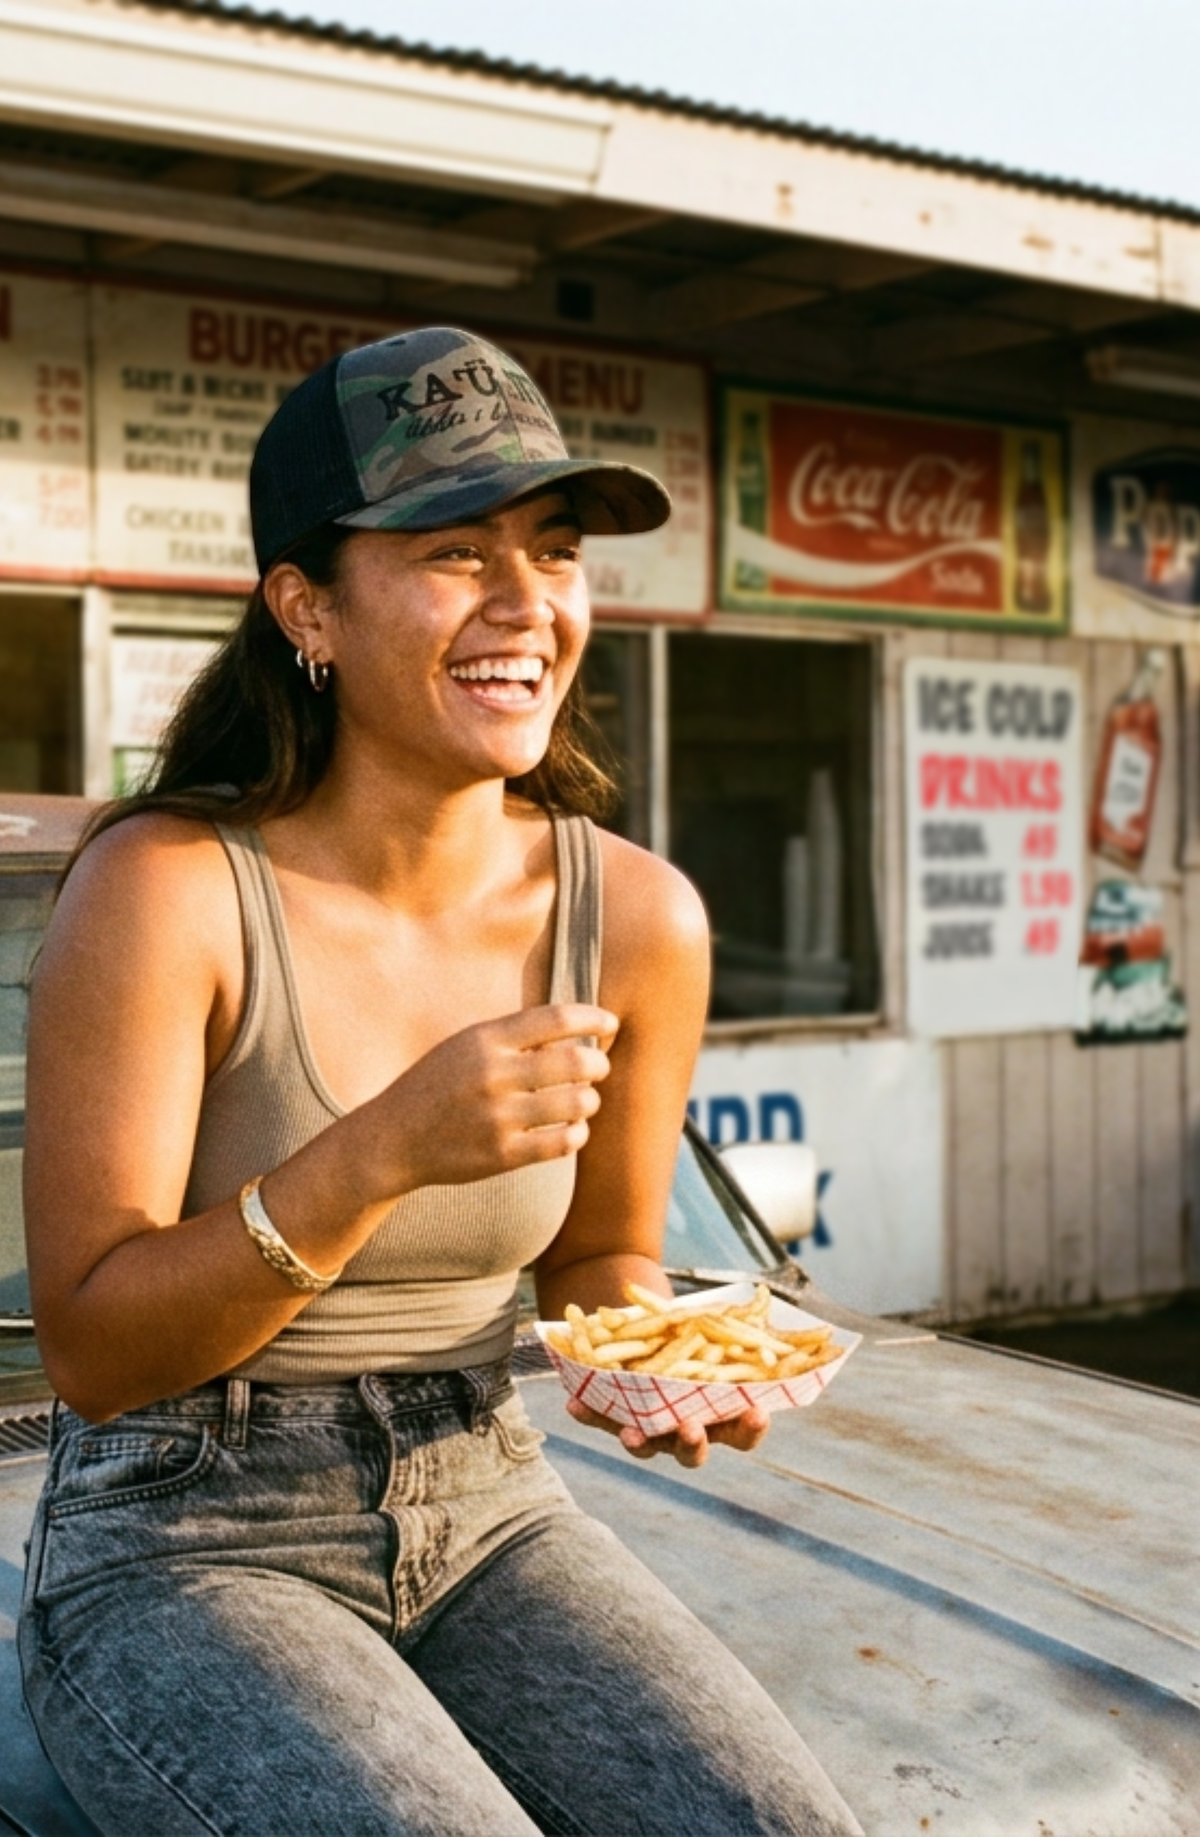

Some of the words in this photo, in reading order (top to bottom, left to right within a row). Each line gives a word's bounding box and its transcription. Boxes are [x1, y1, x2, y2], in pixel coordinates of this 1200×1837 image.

[125, 504, 226, 534] CHICKEN
[917, 674, 976, 735] ICE
[985, 682, 1075, 742] COLD
[920, 752, 1063, 814] DRINKS
